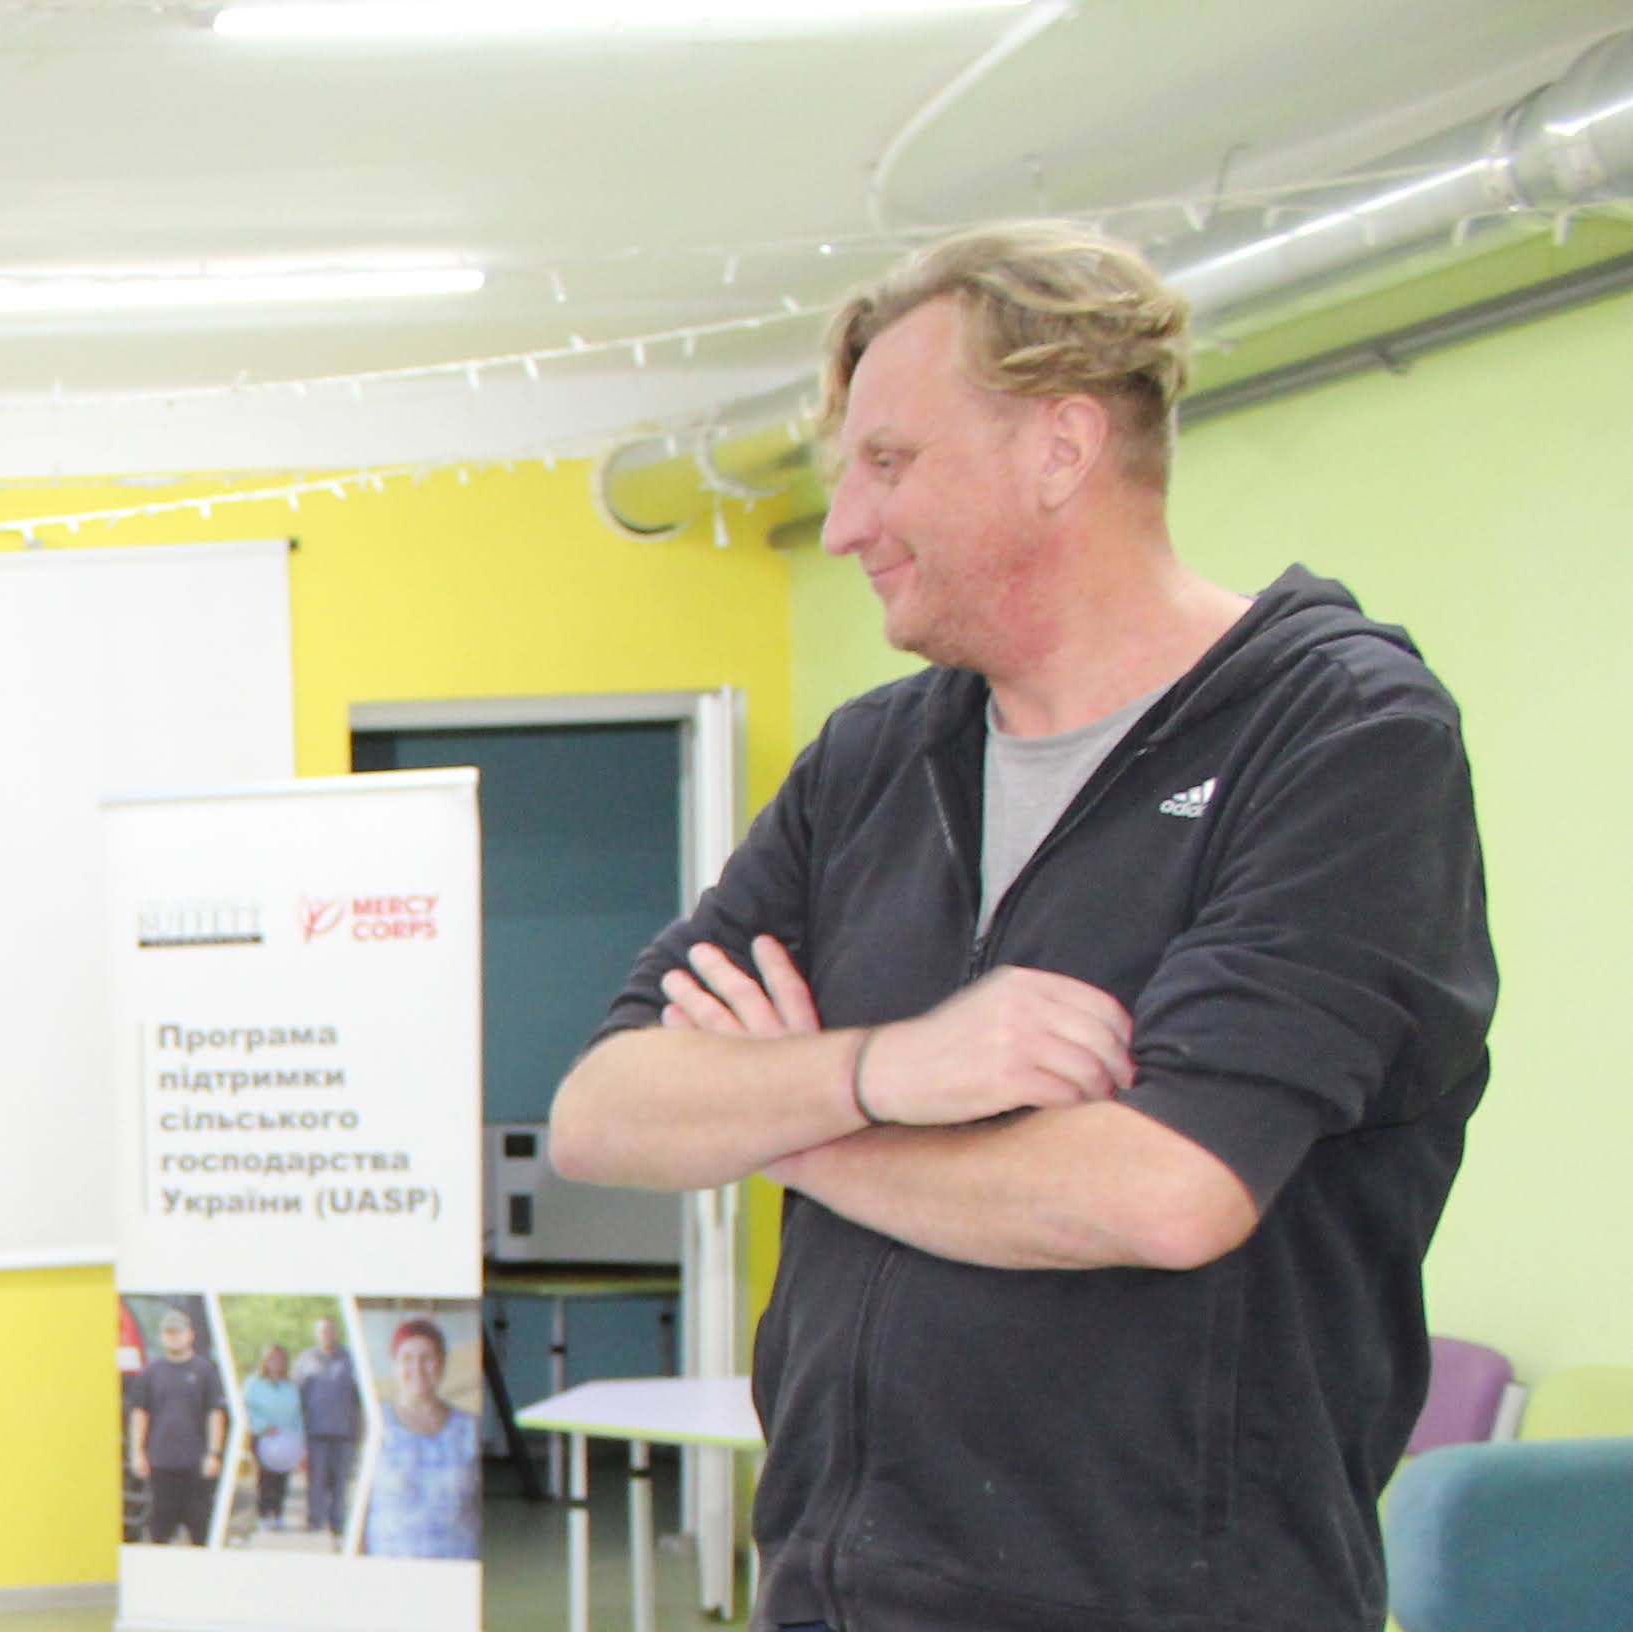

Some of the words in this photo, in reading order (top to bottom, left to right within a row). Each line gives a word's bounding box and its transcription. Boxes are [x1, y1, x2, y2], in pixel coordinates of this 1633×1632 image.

[351, 895, 440, 917] MERCY
[351, 918, 439, 942] CORPS
[158, 1023, 338, 1055] Програма
[158, 1063, 346, 1095] підтримки
[160, 1105, 359, 1132] сільського
[160, 1149, 411, 1177] господарства
[161, 1187, 302, 1219] України
[315, 1186, 442, 1221] (UASP)
